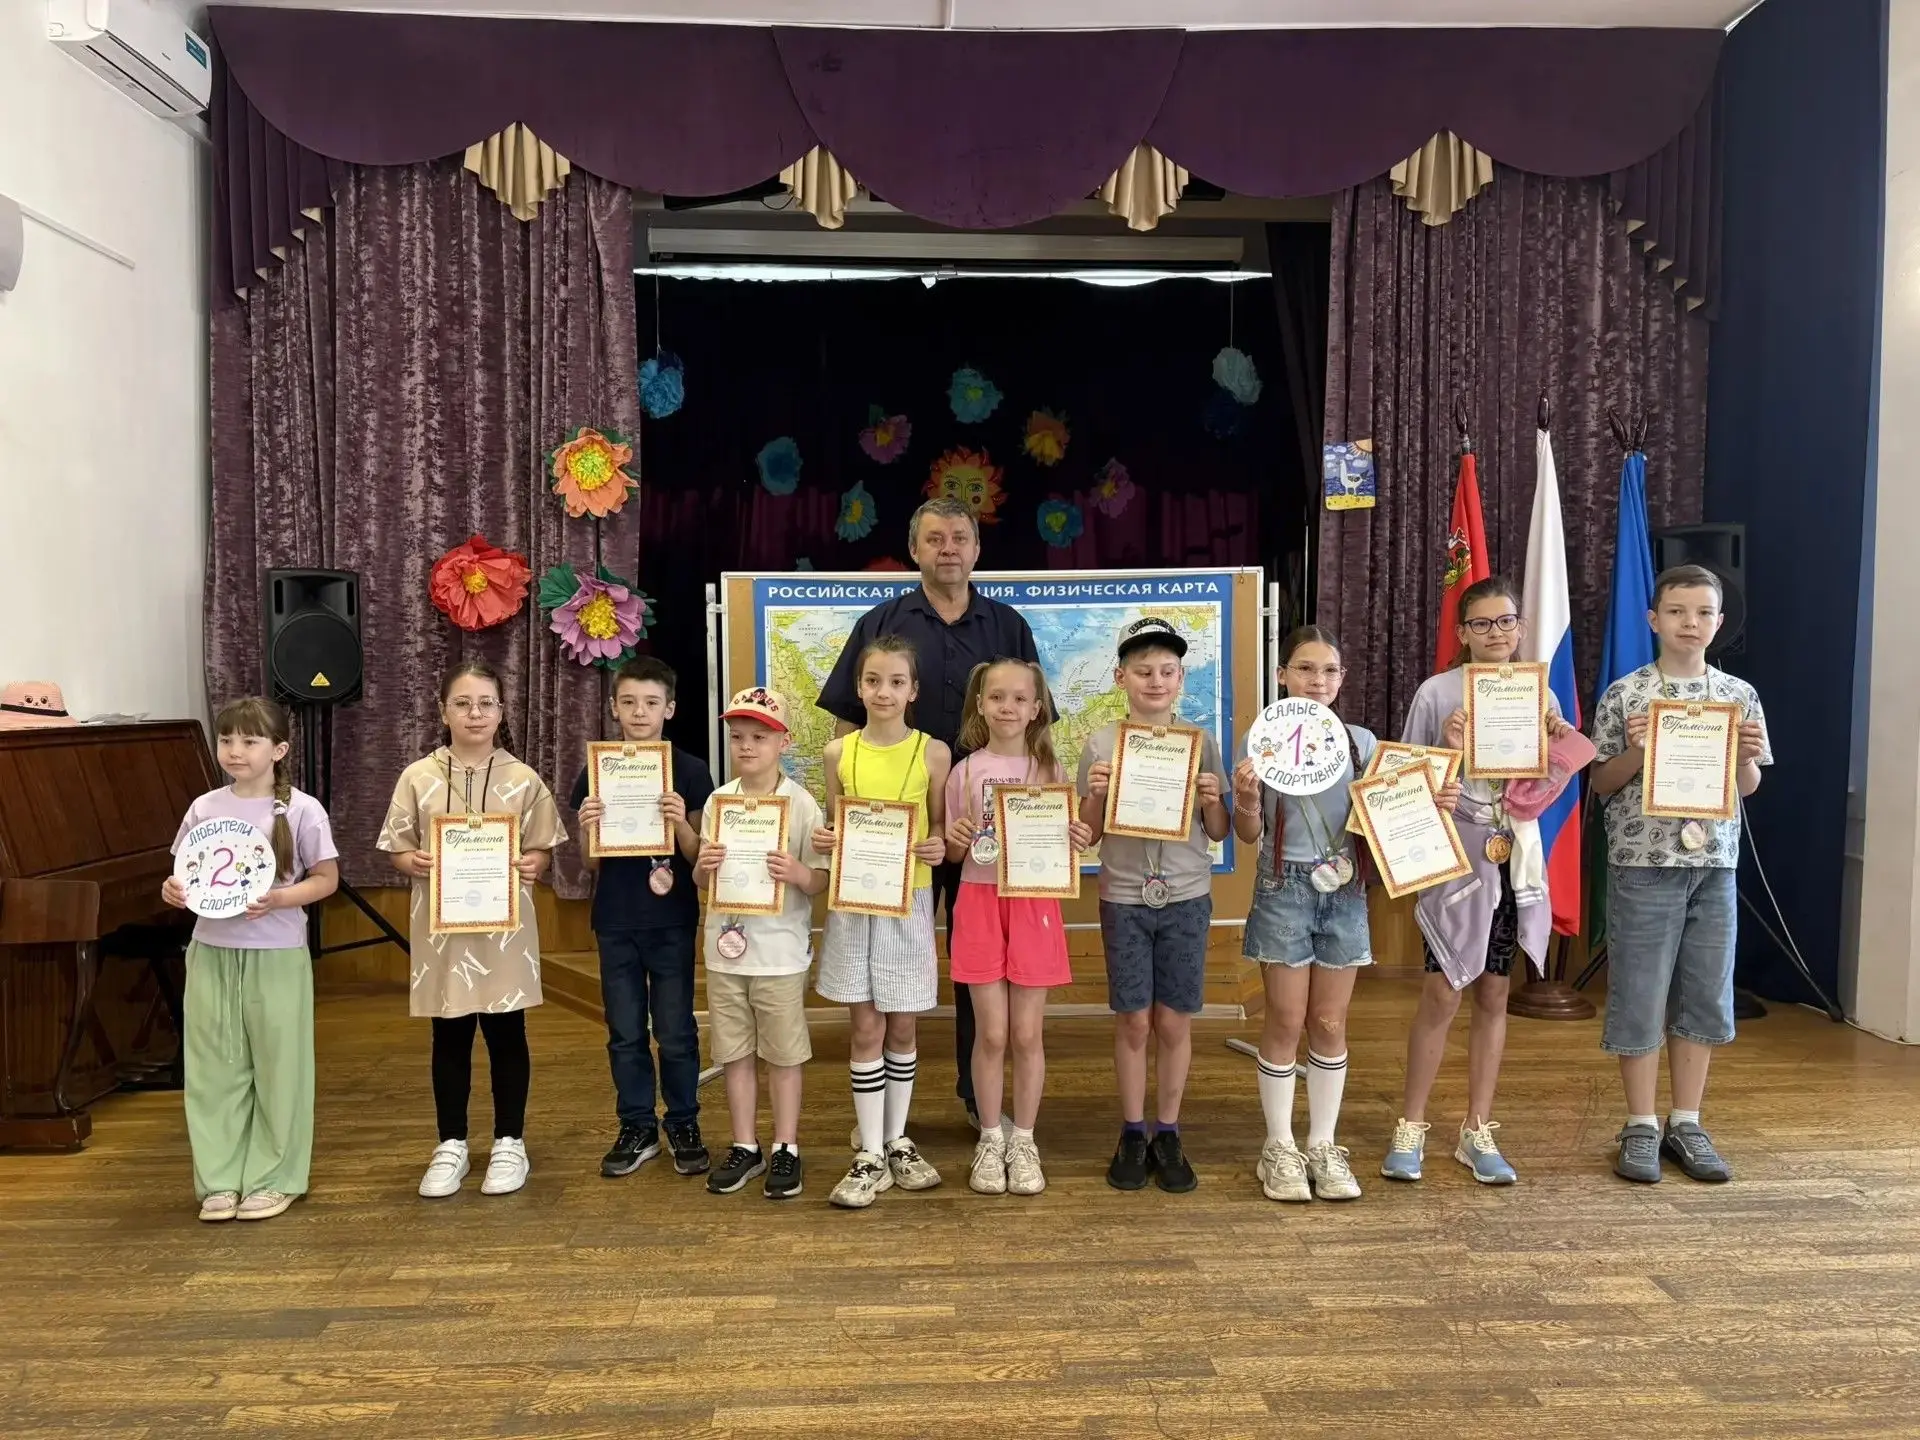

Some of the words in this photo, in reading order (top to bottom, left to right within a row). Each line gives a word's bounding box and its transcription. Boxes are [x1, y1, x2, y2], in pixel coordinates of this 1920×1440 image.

[768, 584, 894, 598] РОССИЙСКАЯ
[1026, 583, 1152, 597] ФИЗИЧЕСКАЯ
[1158, 582, 1219, 594] КАРТА
[1477, 678, 1534, 697] Грамота
[1661, 715, 1723, 735] Грамота
[1128, 734, 1186, 754] Грамота
[1287, 723, 1303, 766] 1
[602, 756, 658, 775] Грамота
[1007, 797, 1063, 815] Грамота
[1366, 784, 1424, 811] Грамота
[724, 810, 776, 829] Грамота
[848, 810, 904, 829] Грамота
[445, 829, 504, 848] Грамота
[210, 847, 238, 888] 2
[199, 892, 248, 910] СПОРТА
